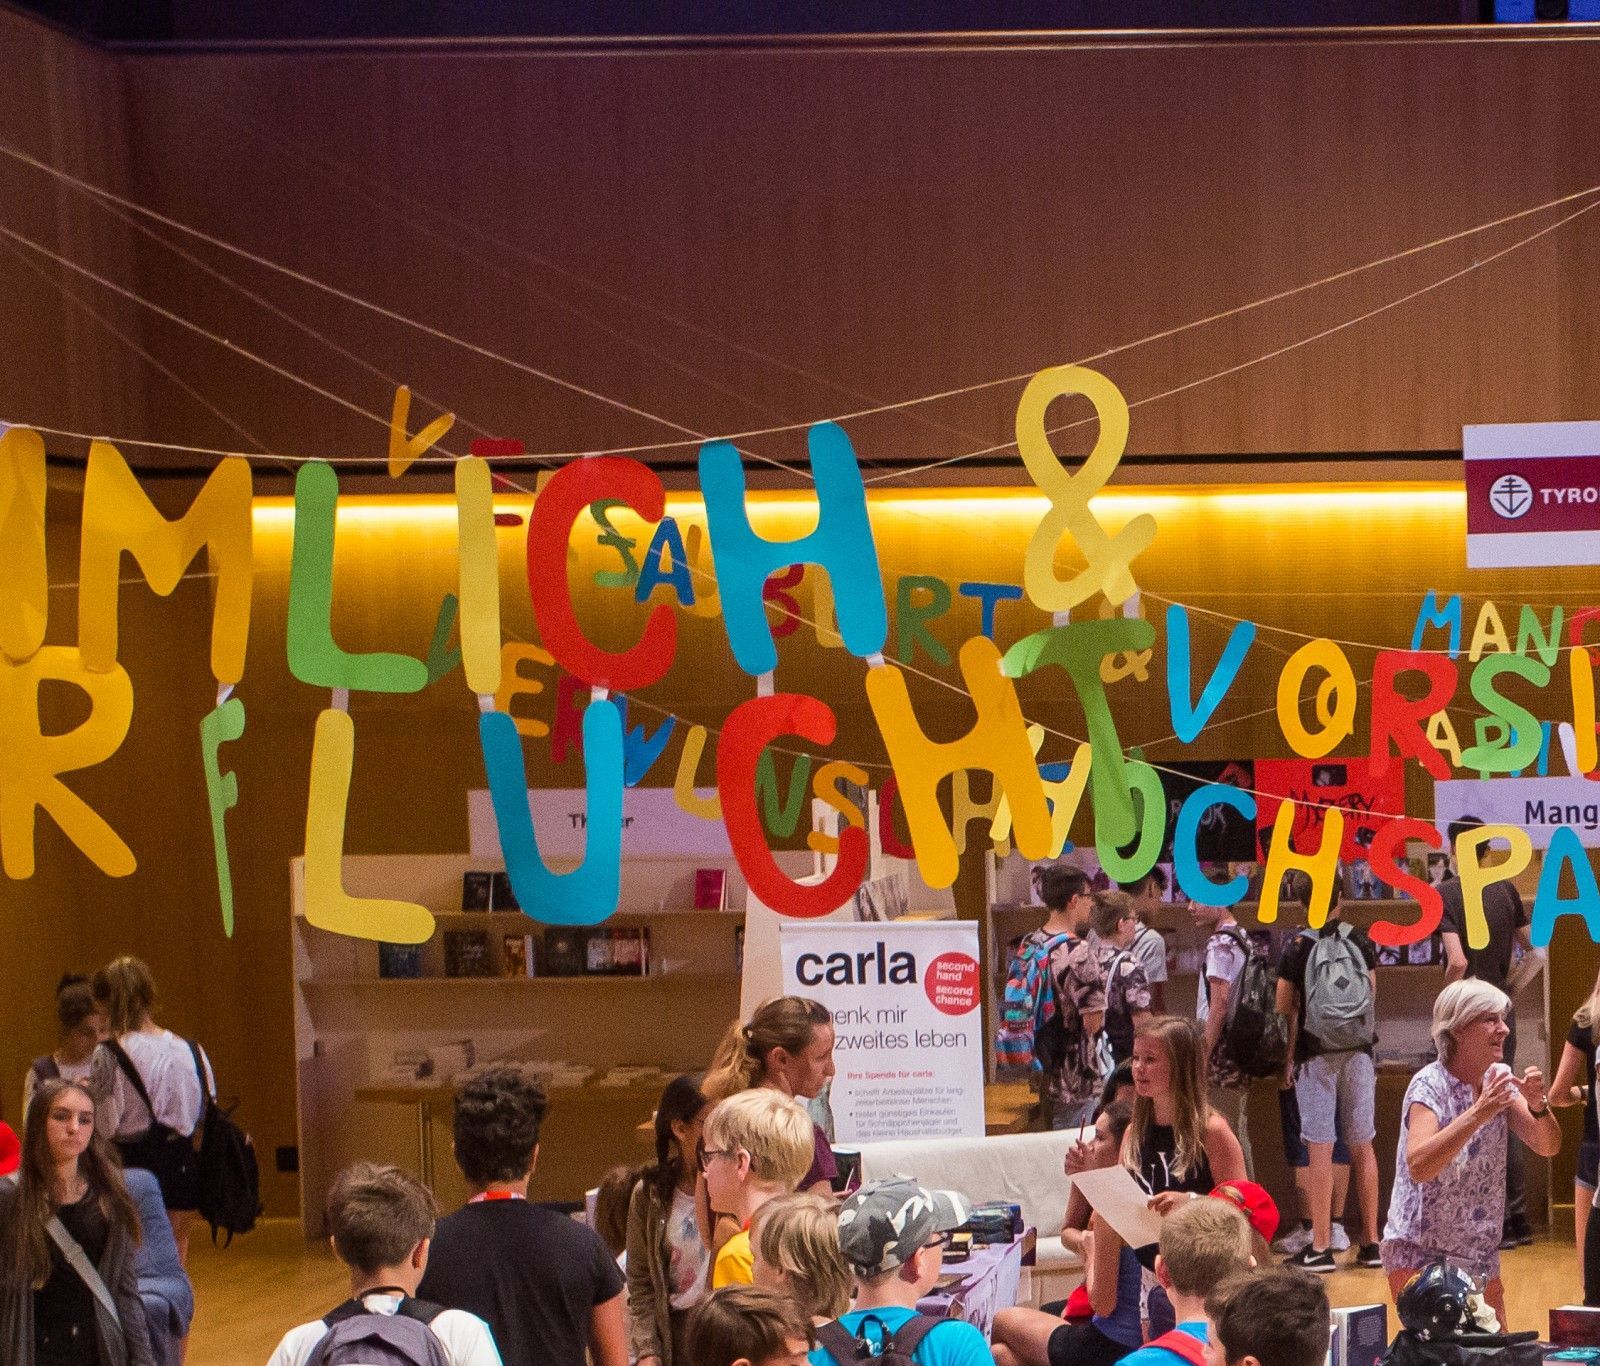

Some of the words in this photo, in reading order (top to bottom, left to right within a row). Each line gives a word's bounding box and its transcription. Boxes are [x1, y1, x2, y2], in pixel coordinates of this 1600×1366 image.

[1015, 364, 1158, 612] &
[795, 941, 917, 986] carla
[936, 961, 975, 973] second
[936, 971, 962, 982] hand
[935, 985, 973, 996] second
[935, 995, 972, 1006] chance
[876, 1003, 908, 1024] mir
[835, 1030, 909, 1050] zweites
[915, 1028, 967, 1048] leben
